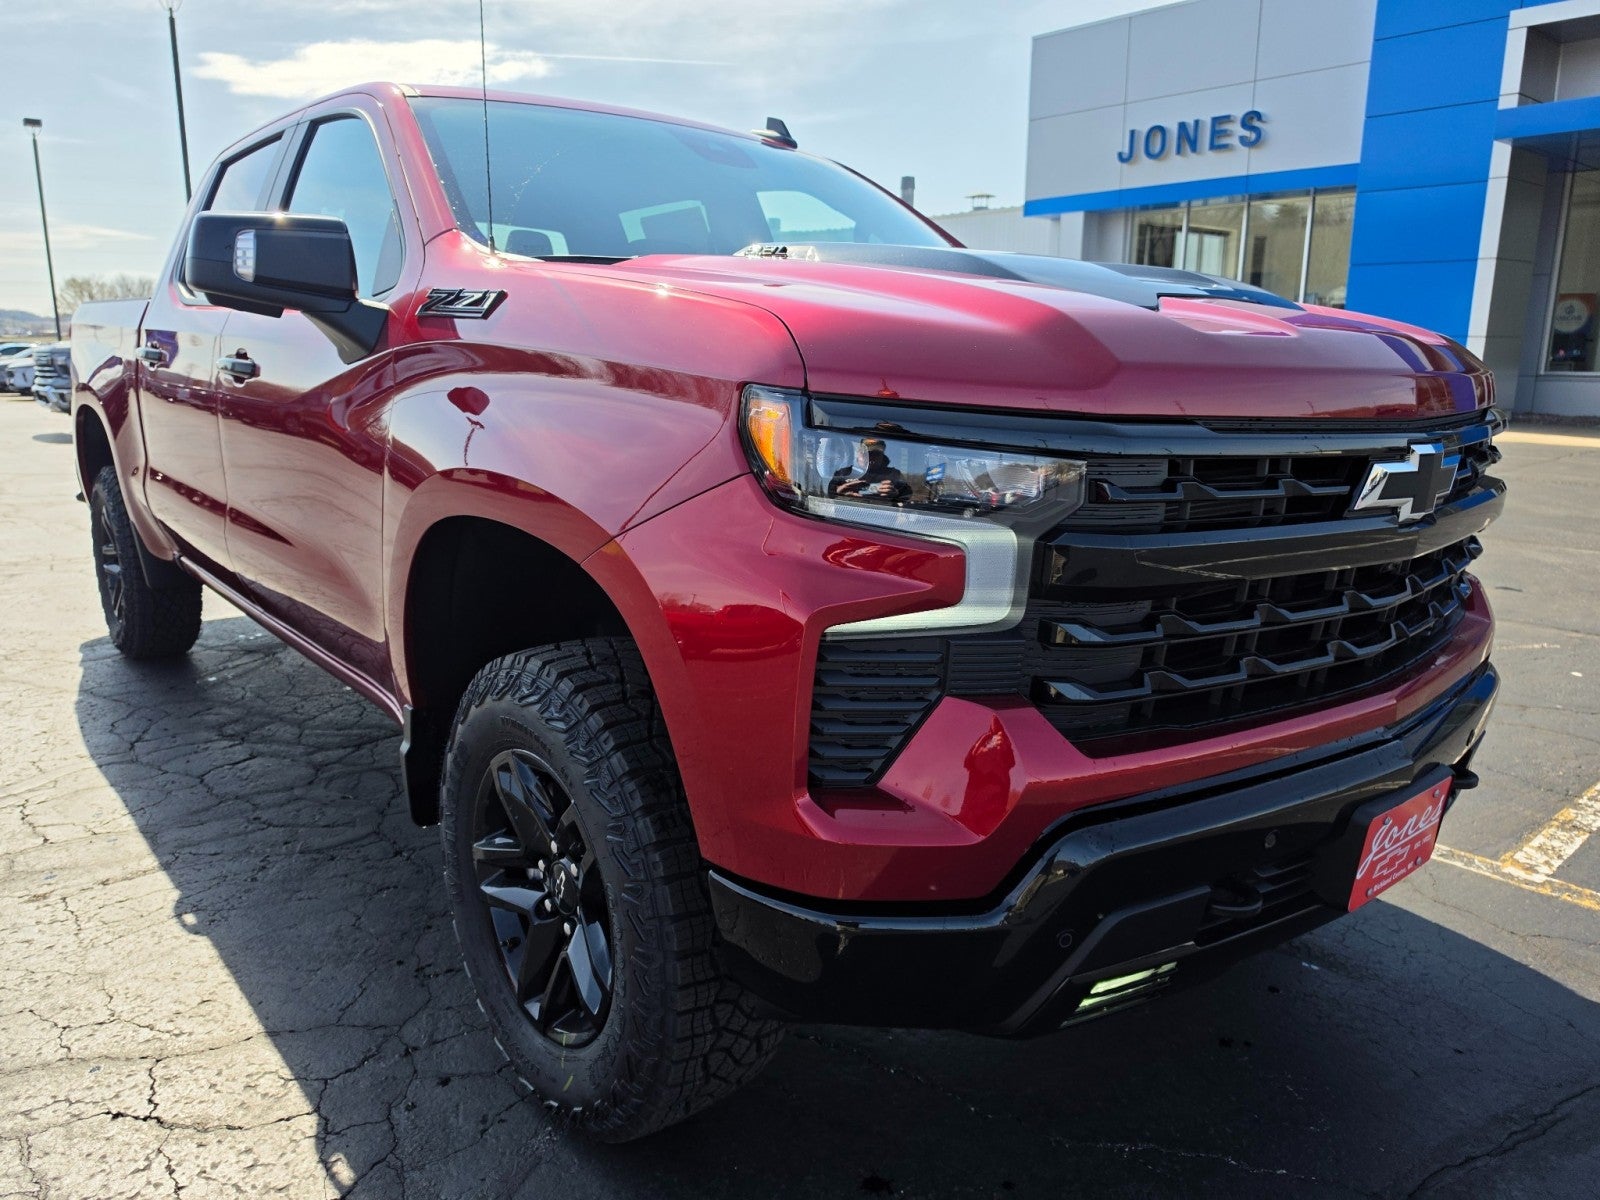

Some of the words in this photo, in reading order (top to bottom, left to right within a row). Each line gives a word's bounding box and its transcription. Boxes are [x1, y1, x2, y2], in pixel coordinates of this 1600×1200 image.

[1117, 110, 1266, 163] JONES
[415, 288, 505, 319] Z71
[1356, 795, 1445, 879] Jones
